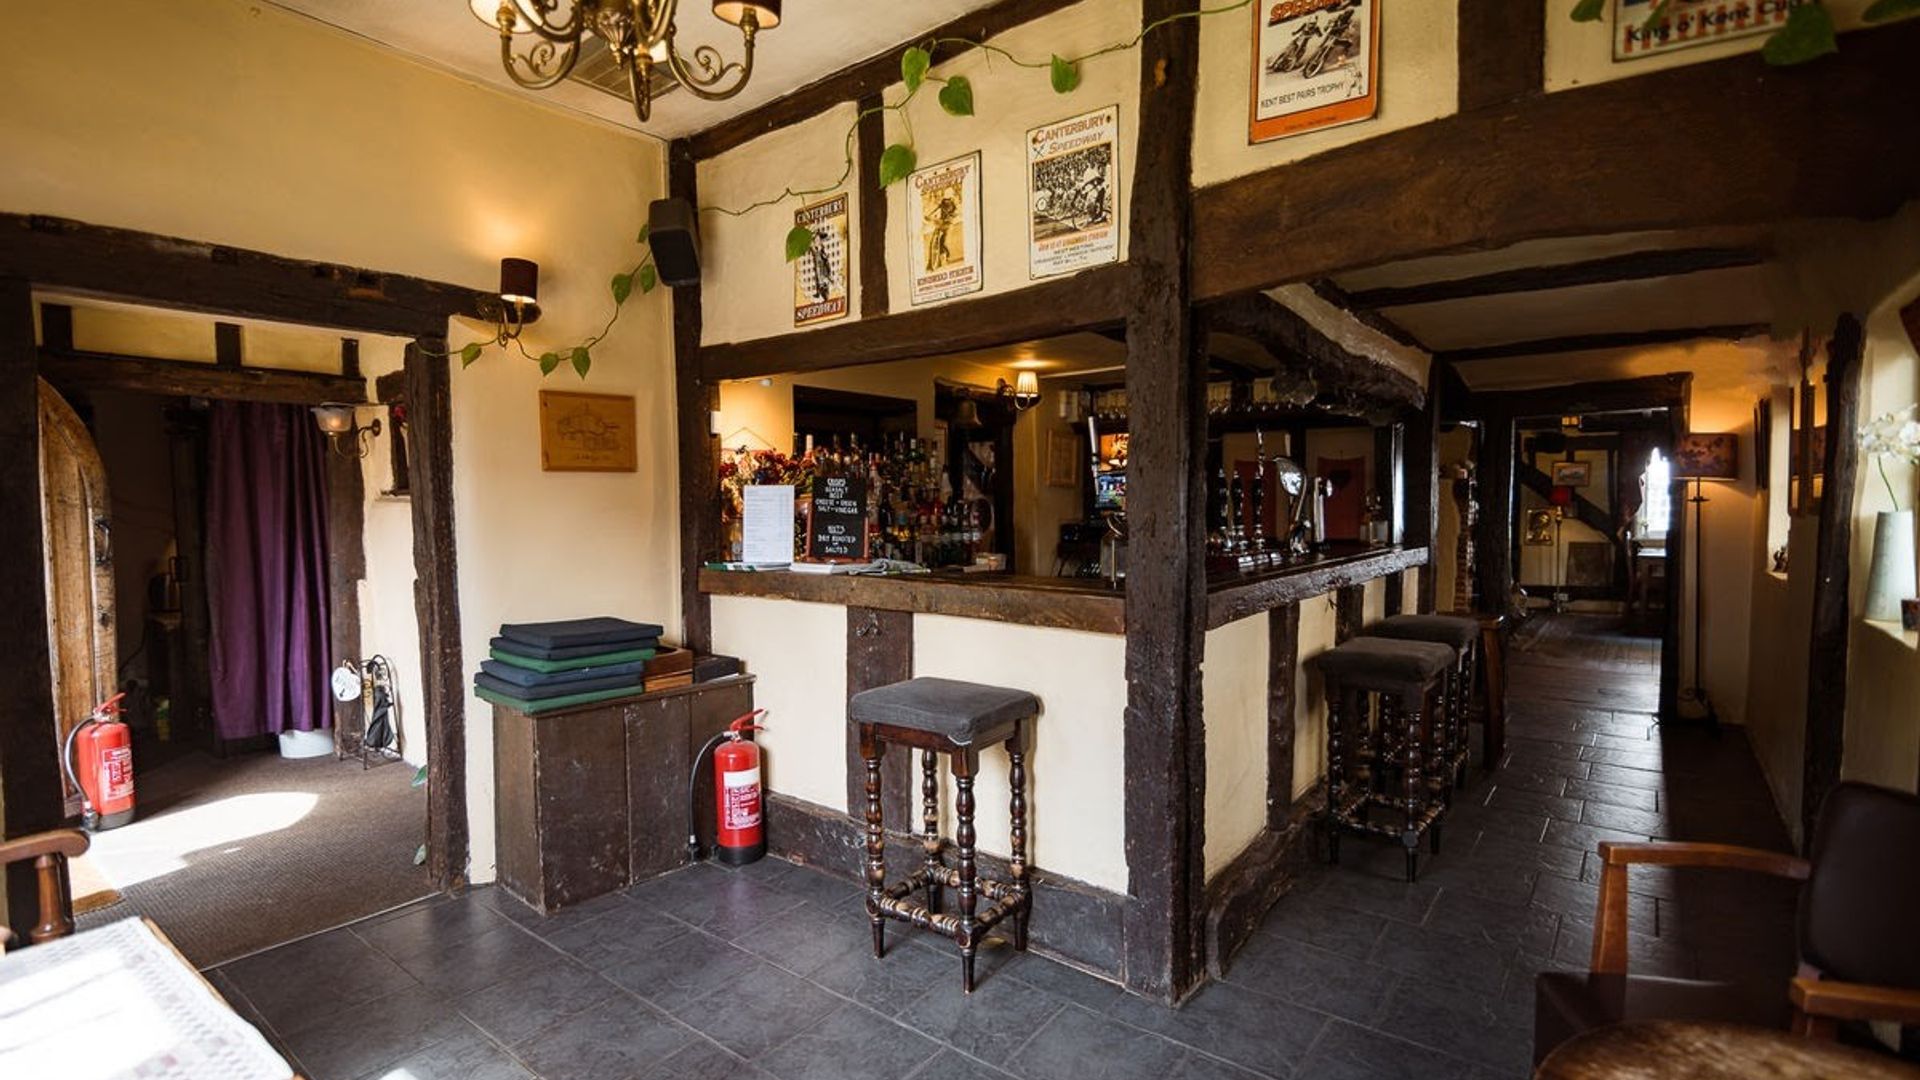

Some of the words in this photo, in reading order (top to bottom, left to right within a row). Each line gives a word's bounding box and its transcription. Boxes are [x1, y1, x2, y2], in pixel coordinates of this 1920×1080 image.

[1702, 6, 1750, 27] Kent
[1279, 92, 1295, 105] BEST
[1296, 88, 1316, 101] PAIRS
[1317, 82, 1344, 96] TROPHY
[1036, 113, 1106, 143] CANTERBURY
[1048, 131, 1104, 154] SPEEDWAY
[797, 299, 842, 321] SPEEDWAY
